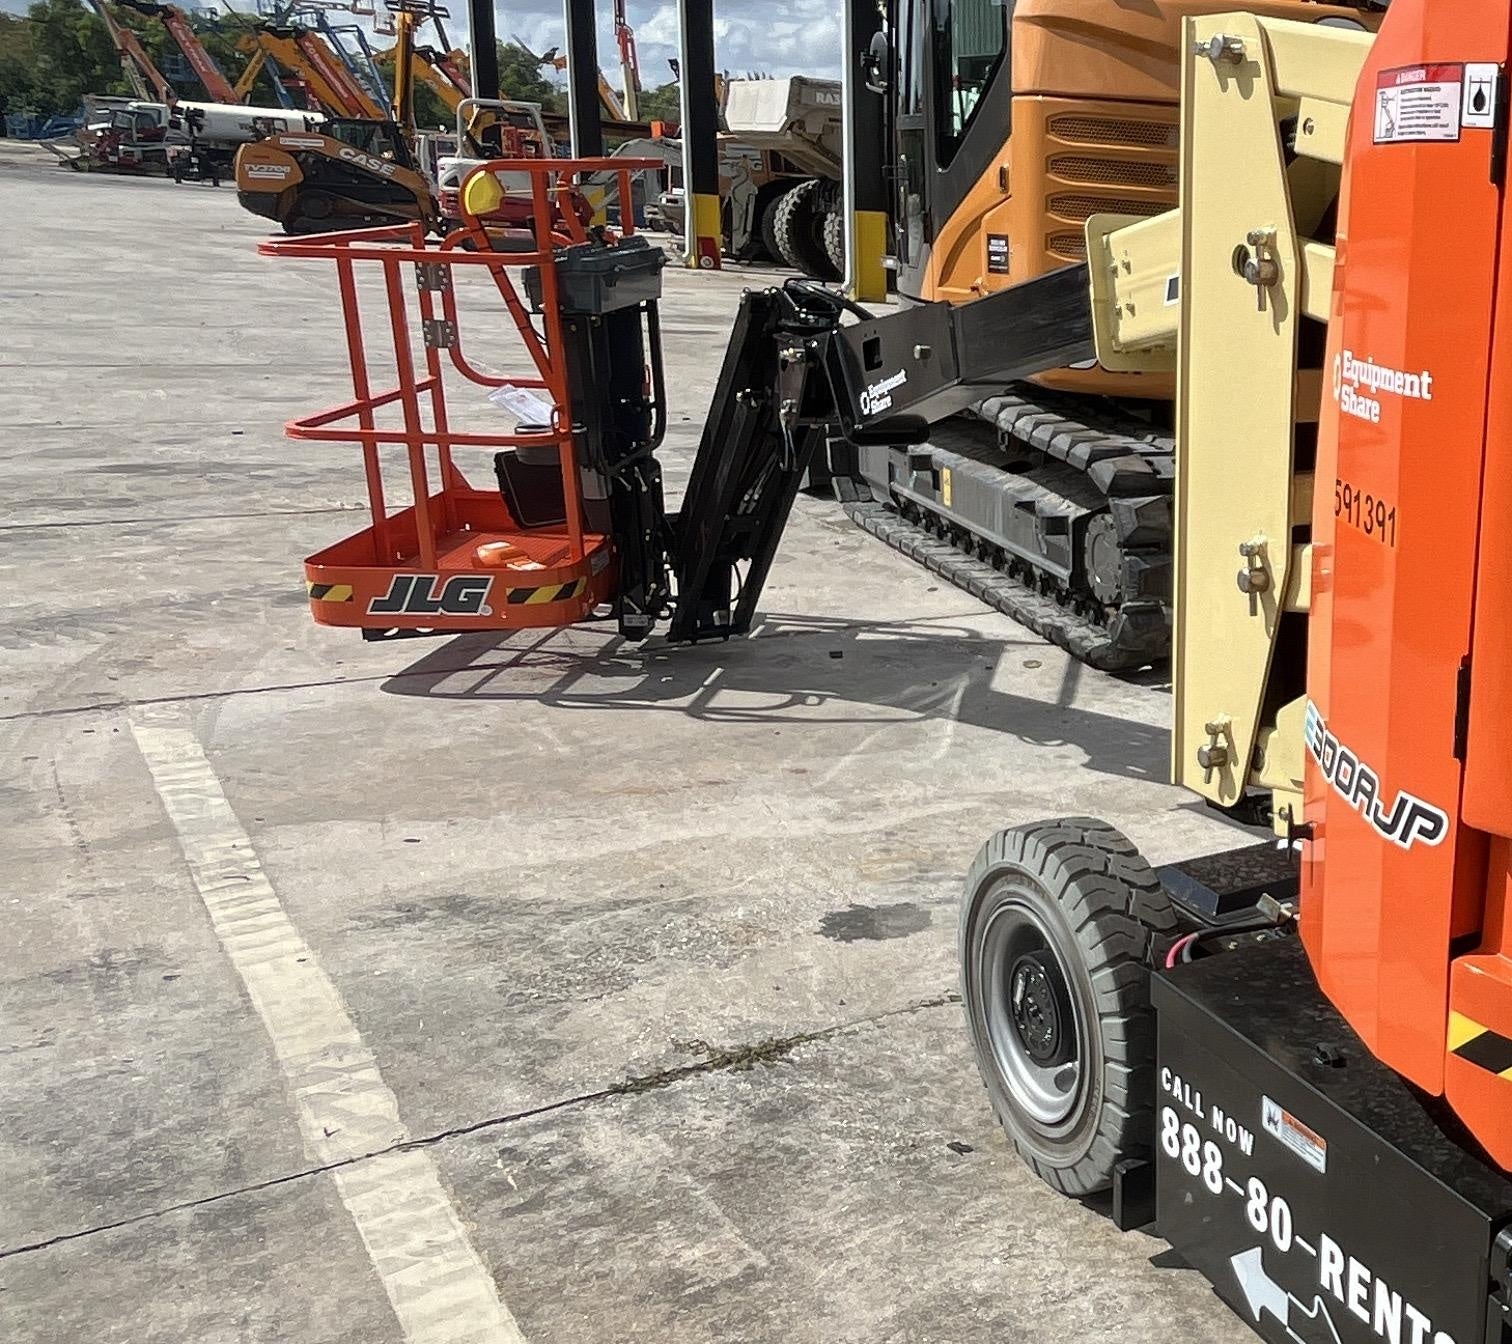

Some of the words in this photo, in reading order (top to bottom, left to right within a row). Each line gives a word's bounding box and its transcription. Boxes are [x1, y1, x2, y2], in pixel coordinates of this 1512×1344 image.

[339, 147, 397, 176] CASE
[1341, 349, 1434, 400] Equipment
[1340, 383, 1382, 425] Share
[1334, 478, 1397, 548] 591391
[367, 574, 495, 615] JLG
[1161, 1066, 1205, 1119] CALL
[1212, 1105, 1256, 1157] NOW
